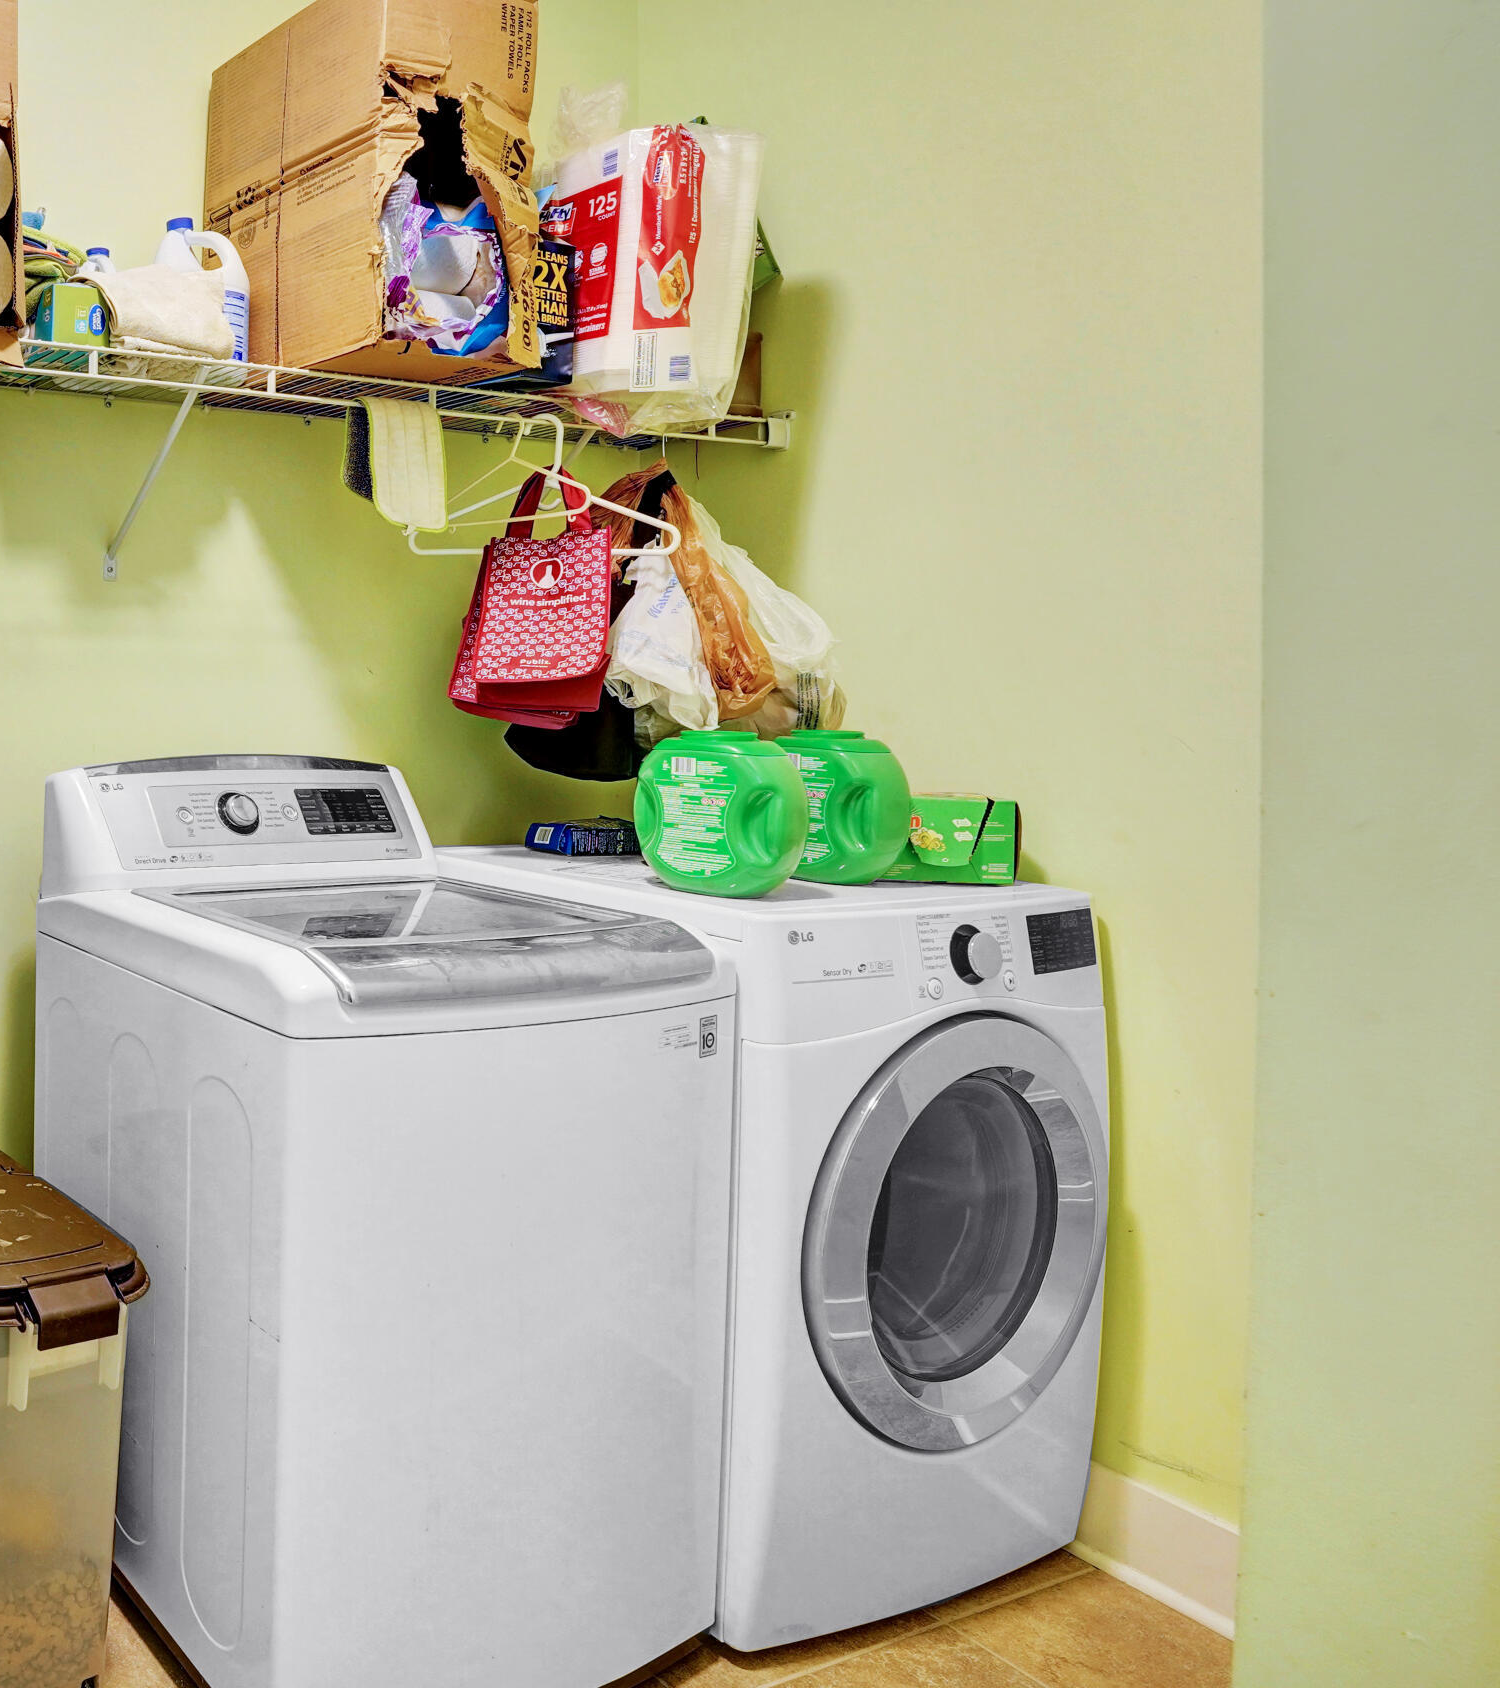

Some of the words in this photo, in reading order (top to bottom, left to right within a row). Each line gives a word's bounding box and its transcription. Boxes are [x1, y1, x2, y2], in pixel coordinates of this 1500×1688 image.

[507, 40, 515, 79] TOWELS
[522, 60, 531, 94] PACKS
[589, 191, 617, 218] 125
[533, 260, 567, 293] 2X
[535, 287, 567, 303] BETTER
[510, 598, 535, 606] wine
[536, 592, 590, 607] simplified.
[801, 931, 814, 942] LG
[842, 968, 852, 976] Dry
